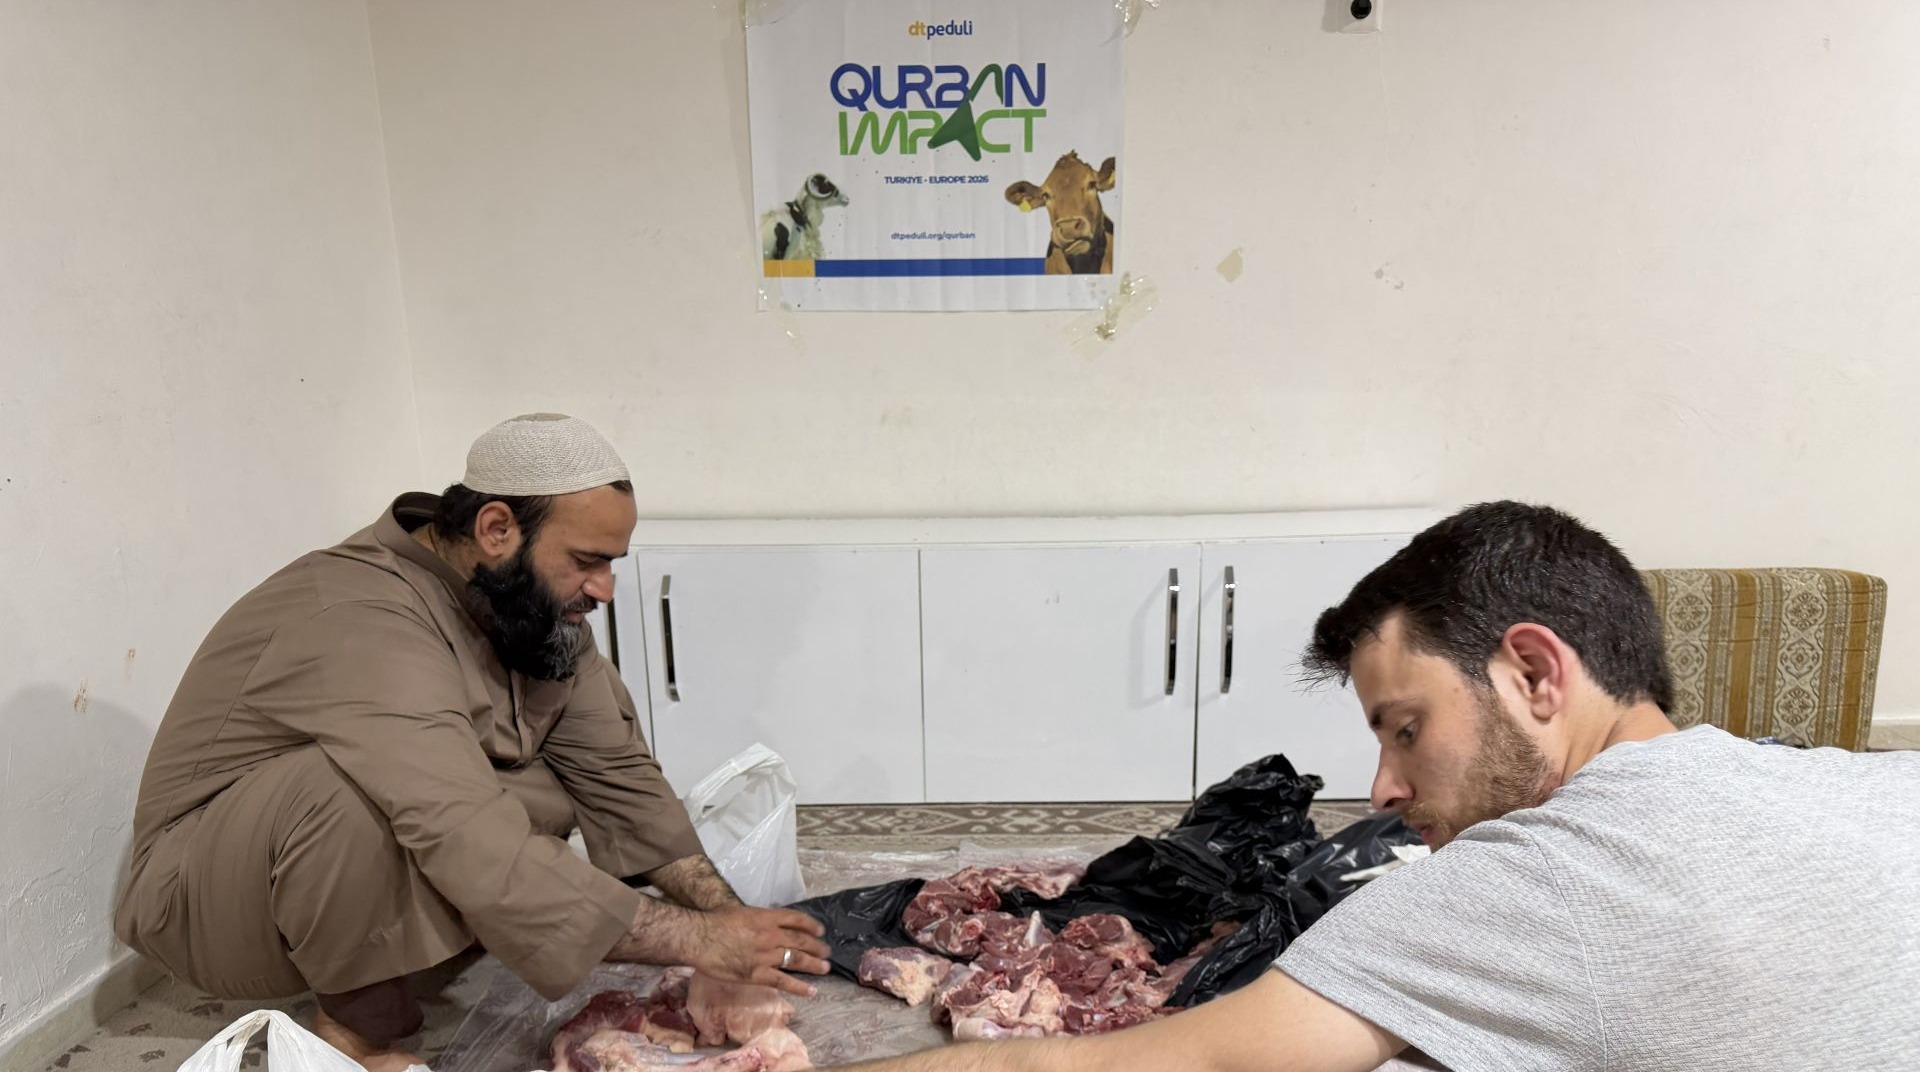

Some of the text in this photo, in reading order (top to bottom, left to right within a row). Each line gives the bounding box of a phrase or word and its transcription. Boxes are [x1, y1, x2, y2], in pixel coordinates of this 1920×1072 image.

[830, 63, 1046, 111] QURBAN
[839, 109, 1047, 161] IMPACT
[884, 175, 923, 184] TURKIYE
[929, 175, 966, 184] EUROPE
[890, 231, 976, 241] dtpeduli.org/qurban
